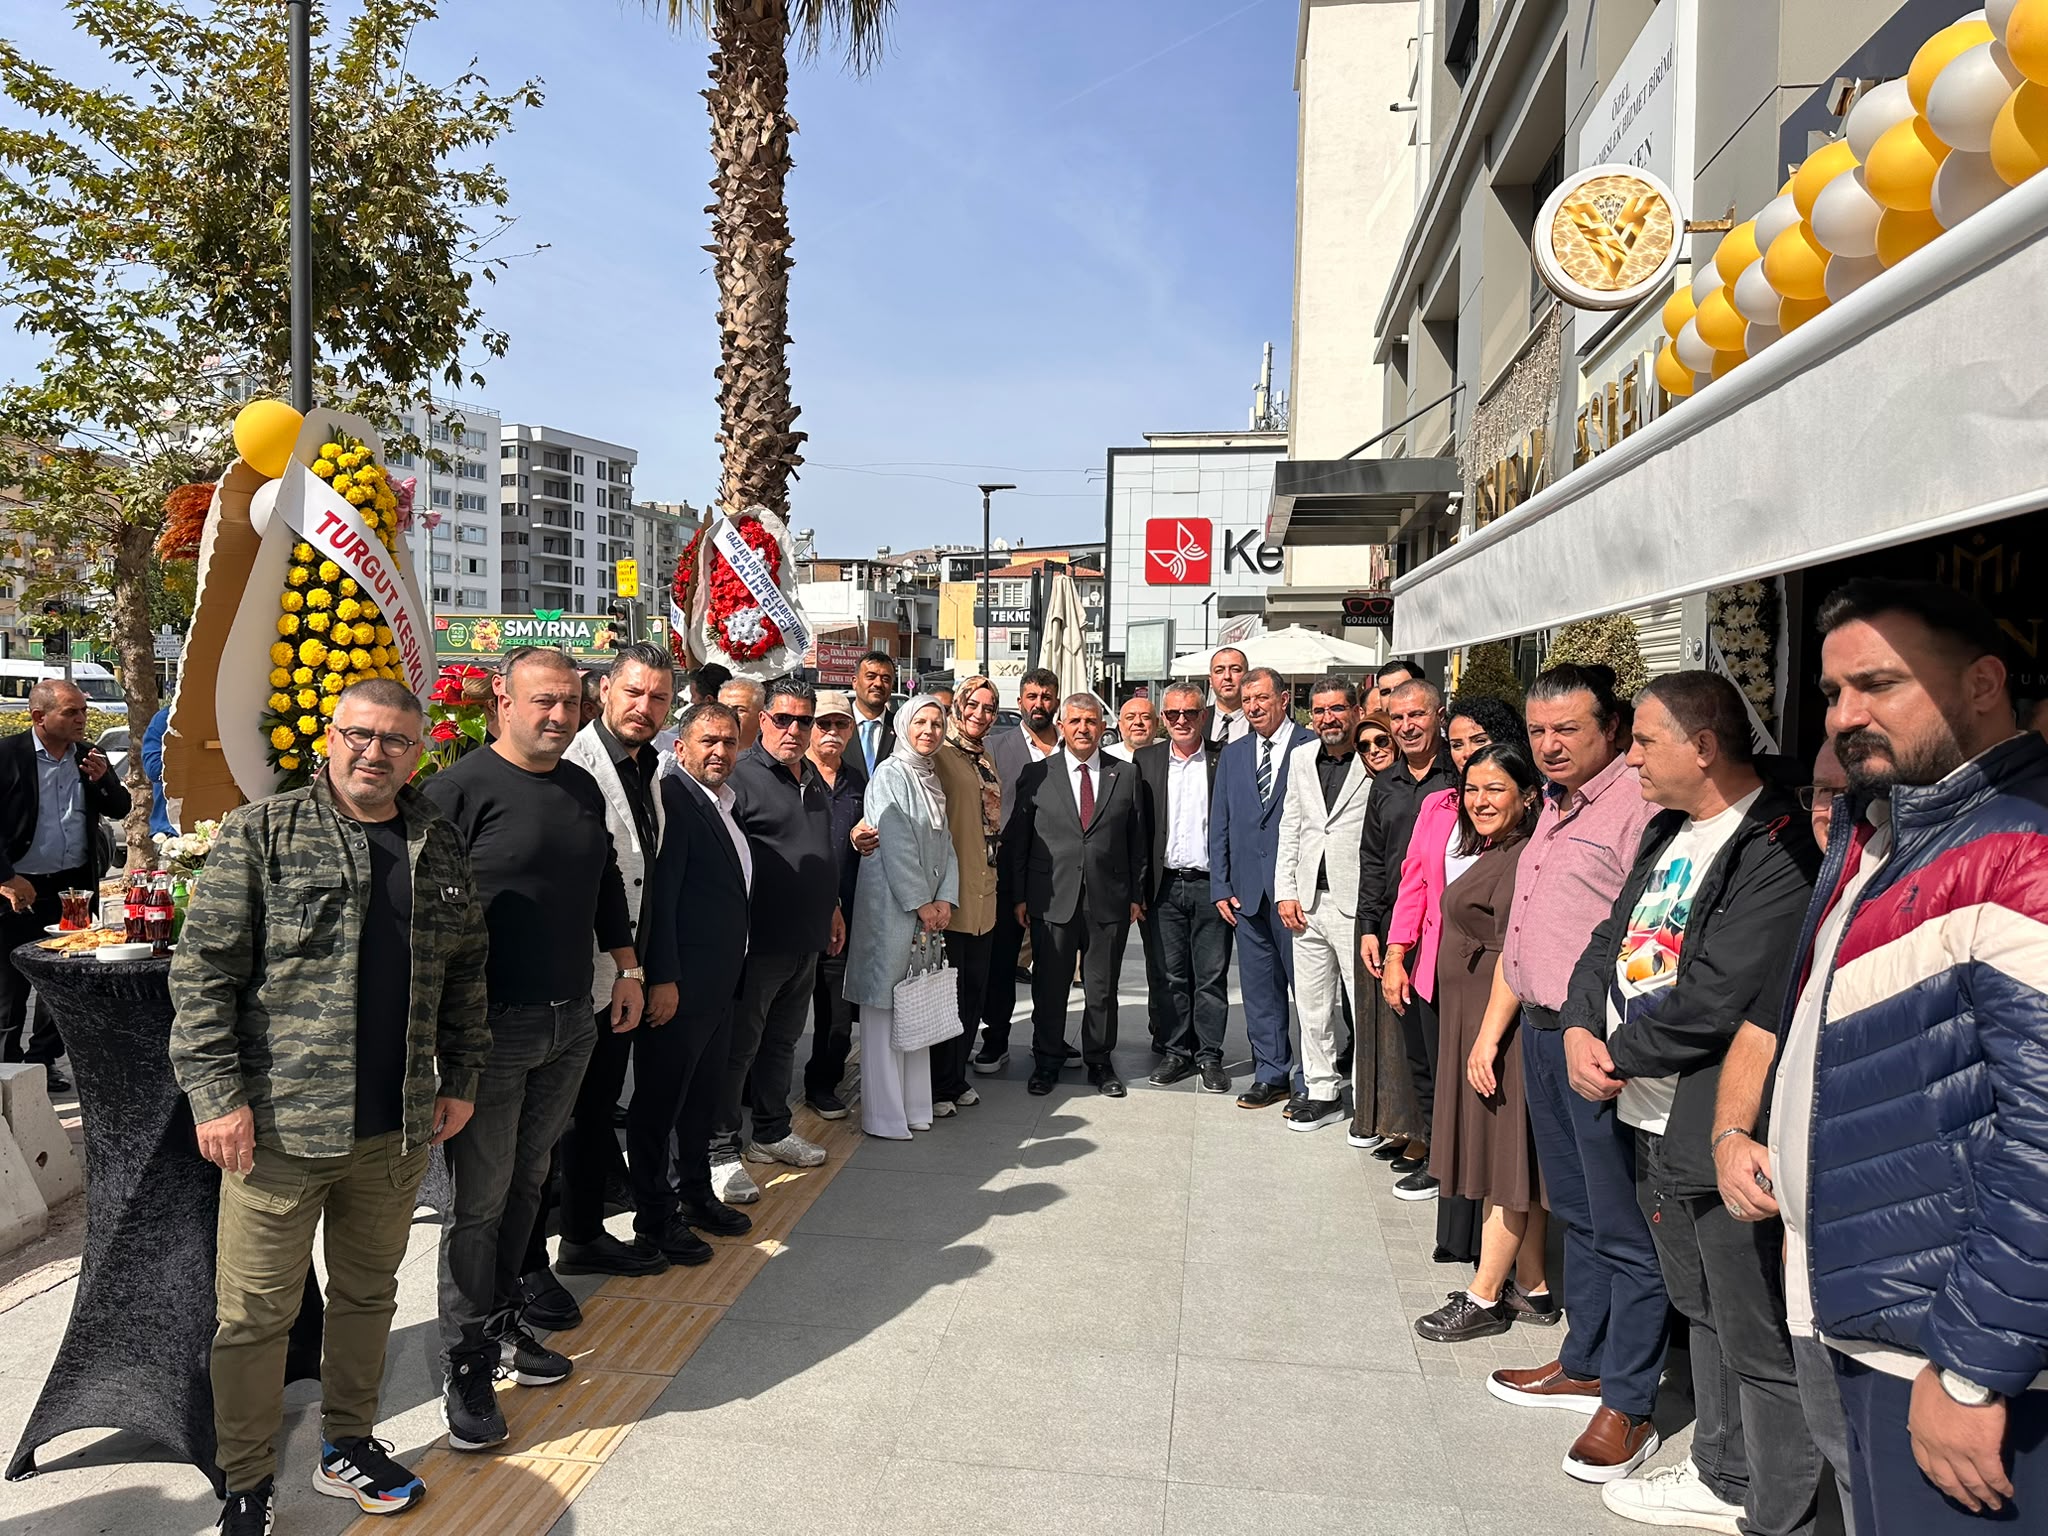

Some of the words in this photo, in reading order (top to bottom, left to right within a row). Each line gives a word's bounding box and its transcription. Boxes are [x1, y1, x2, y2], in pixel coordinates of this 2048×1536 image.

[1611, 81, 1630, 121] ÖZEL
[1622, 83, 1648, 135] HİZMET
[1648, 42, 1673, 97] BİRİMİ
[315, 510, 399, 607] TURGUT
[725, 531, 744, 550] GAZİ
[739, 548, 753, 563] ATA
[749, 560, 762, 575] DİŞ
[759, 572, 779, 602] PORTEZ
[775, 599, 810, 651] LABORATUVARI
[730, 554, 764, 596] SALİH
[504, 621, 591, 638] SMYRNA
